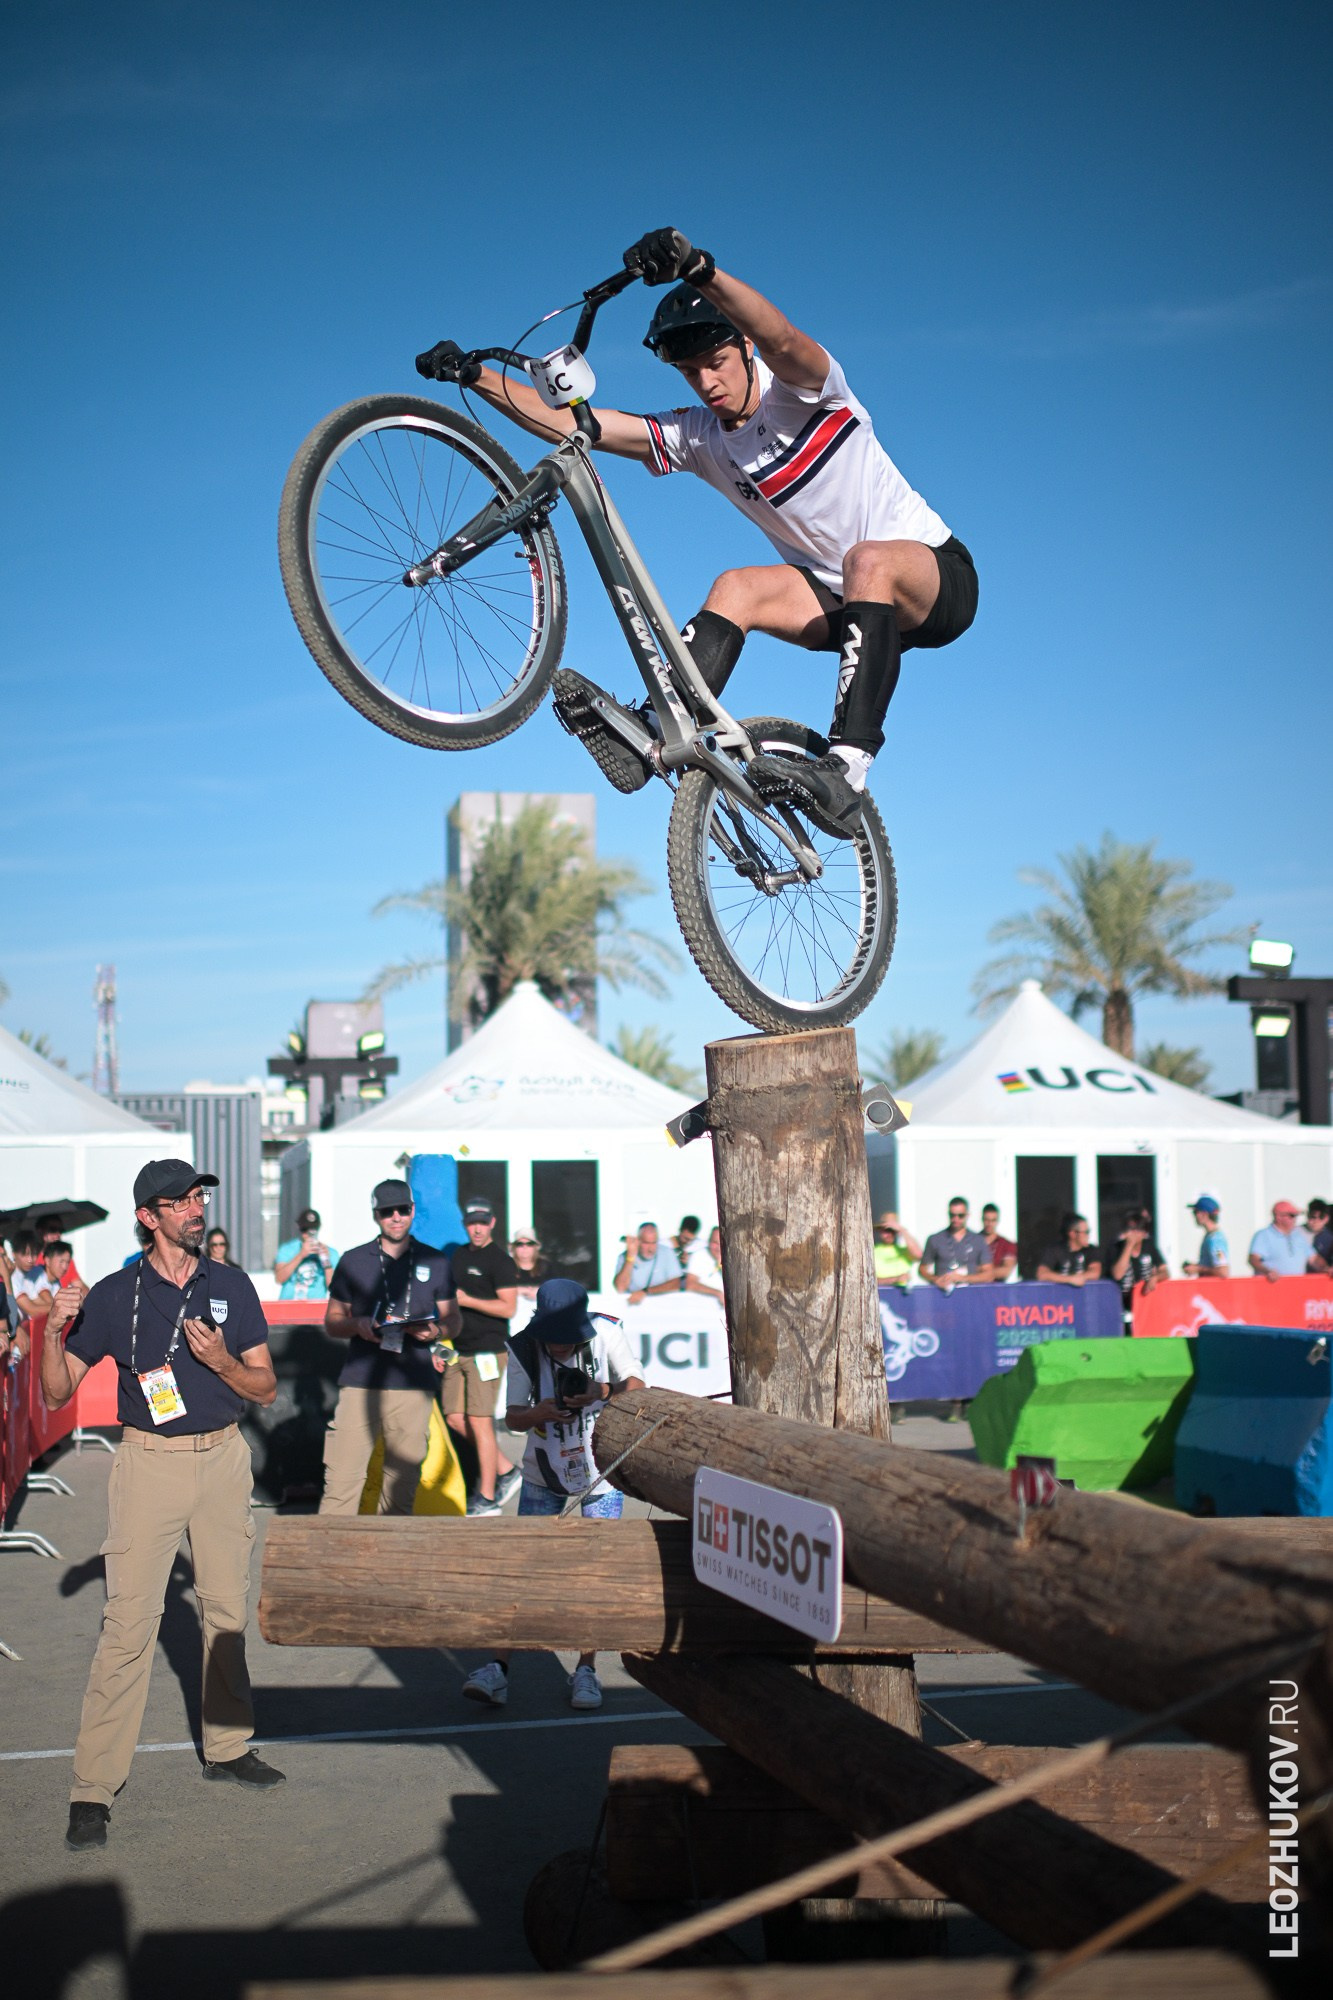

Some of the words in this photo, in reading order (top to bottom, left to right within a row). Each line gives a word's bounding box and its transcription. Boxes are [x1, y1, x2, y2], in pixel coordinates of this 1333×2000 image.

[546, 372, 573, 396] 6C
[493, 494, 533, 524] WAW
[1025, 1066, 1157, 1095] UCI
[214, 1307, 227, 1315] UCI
[996, 1304, 1074, 1326] RIYADH
[732, 1508, 832, 1594] TISSOT
[697, 1553, 722, 1576] SWISS
[727, 1565, 768, 1596] WATCHES
[773, 1585, 800, 1612] SINCE
[807, 1601, 831, 1625] 1853
